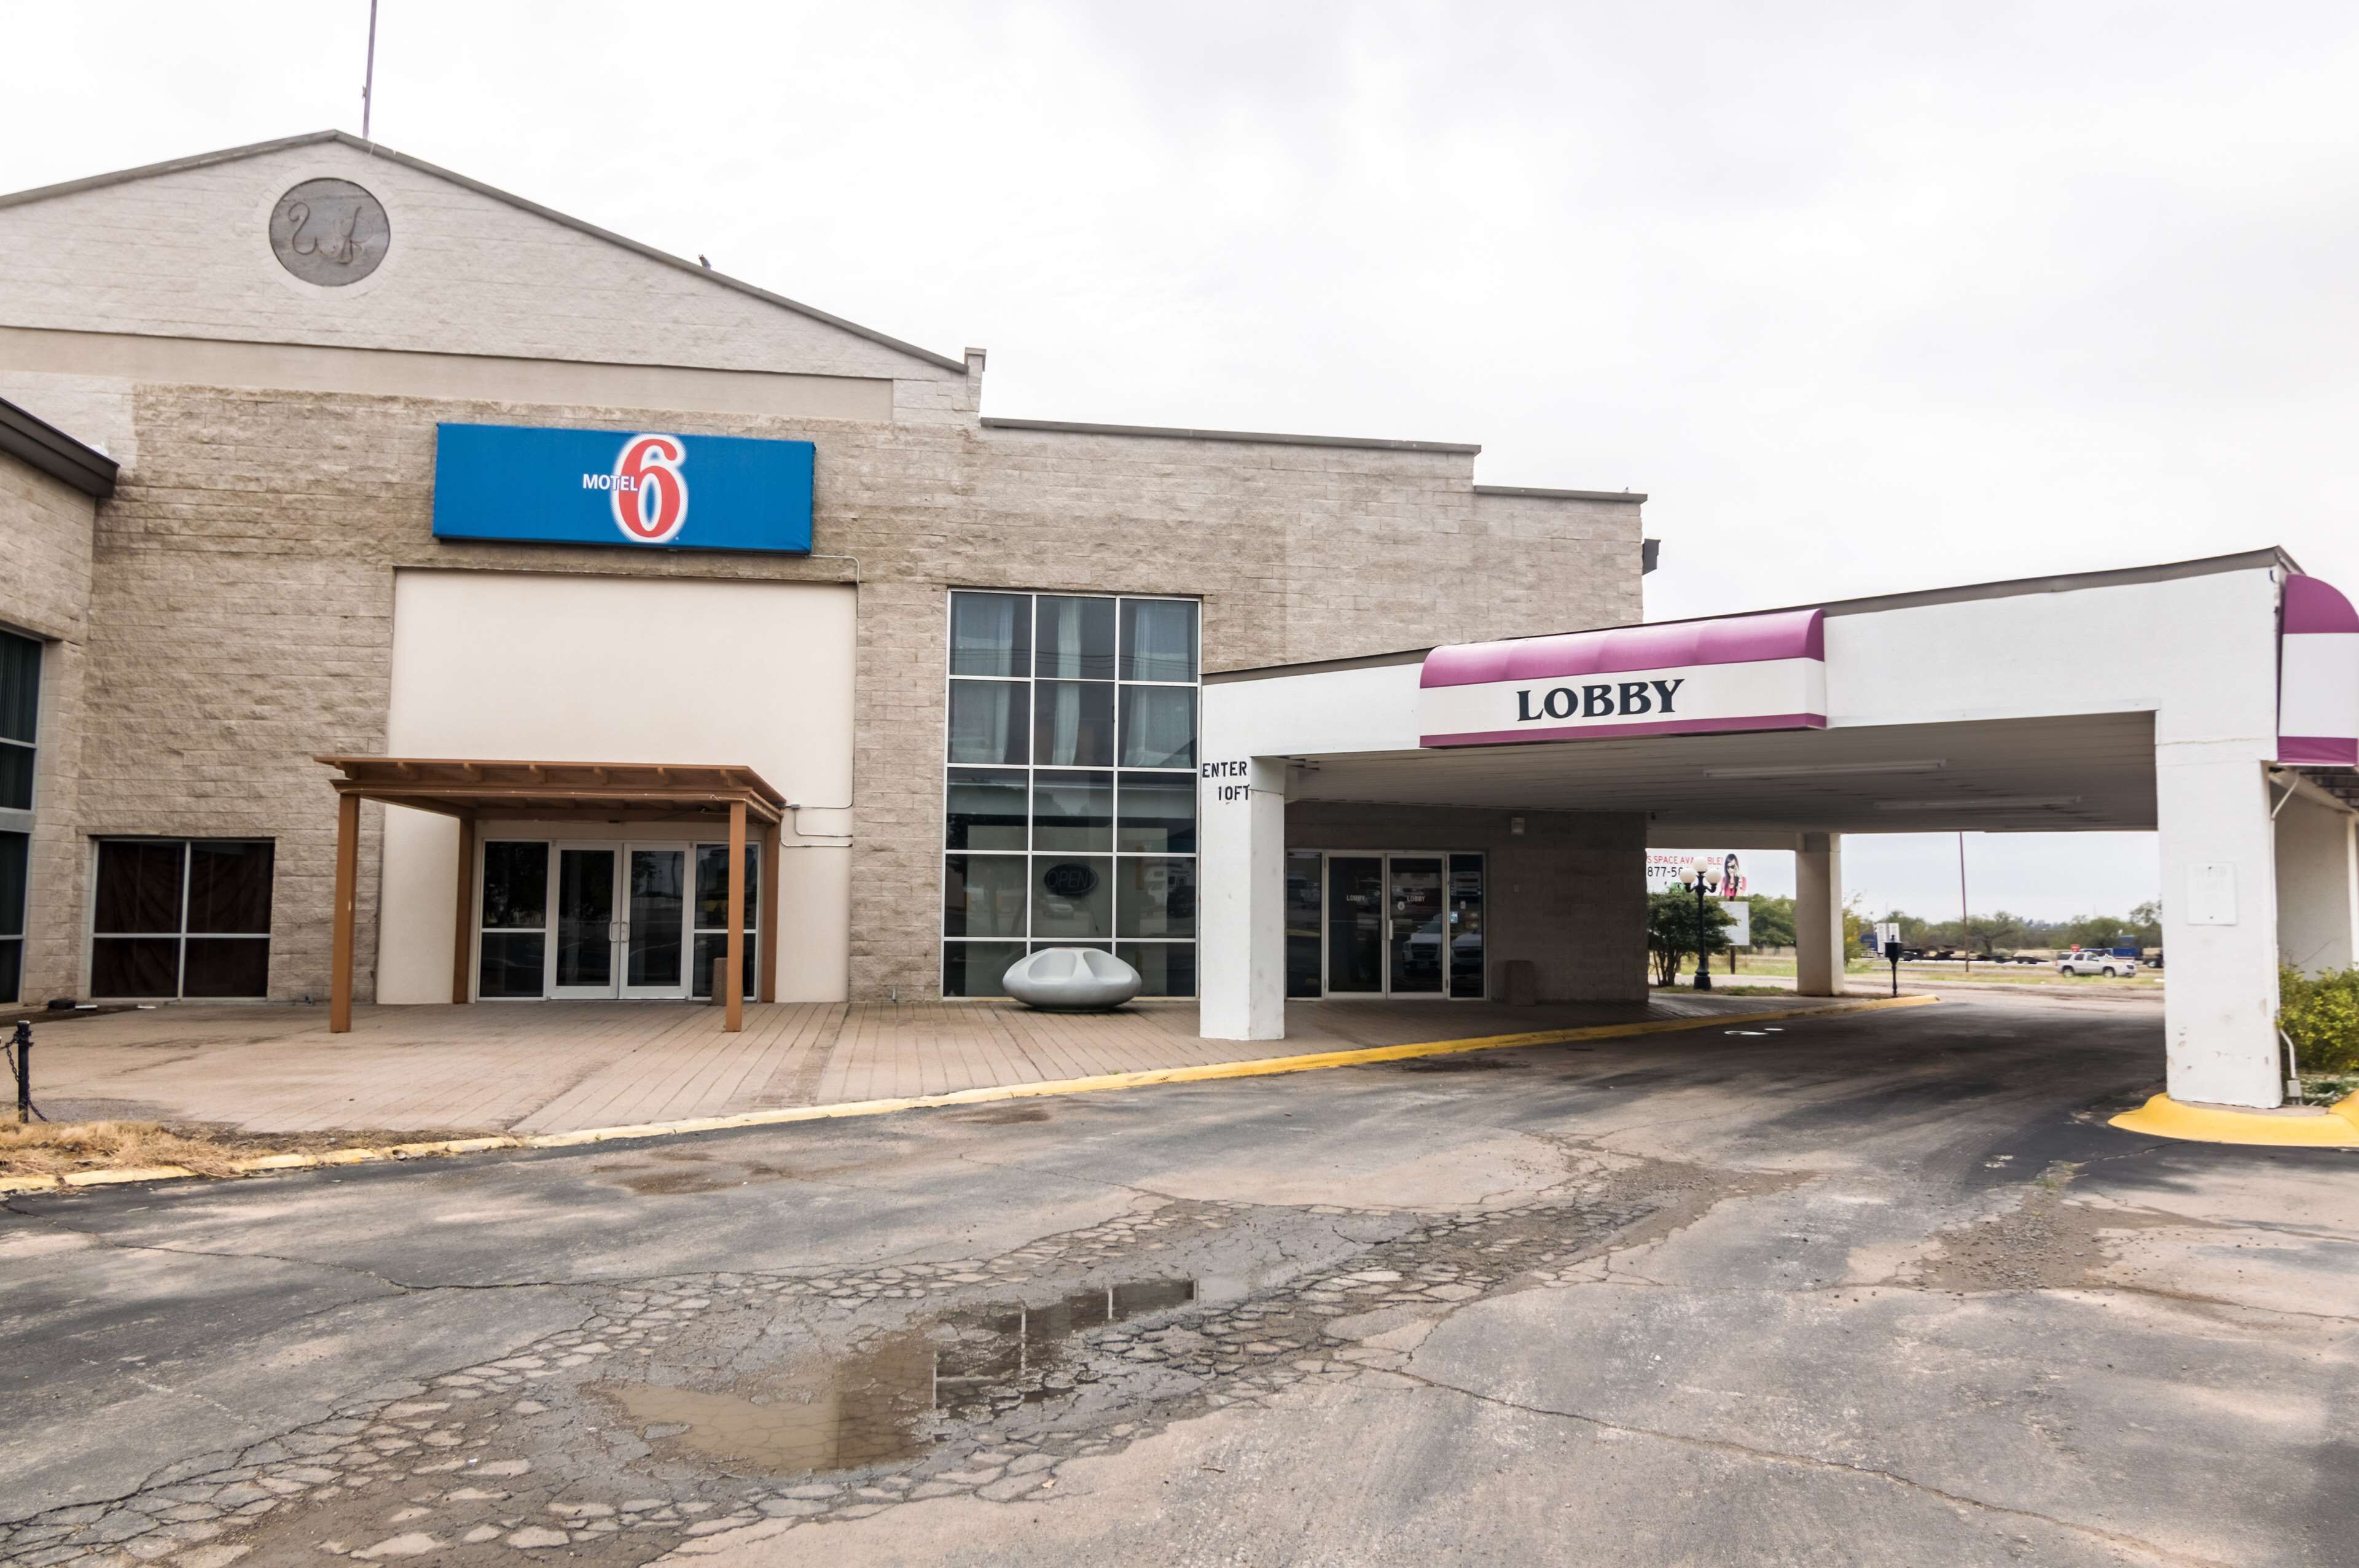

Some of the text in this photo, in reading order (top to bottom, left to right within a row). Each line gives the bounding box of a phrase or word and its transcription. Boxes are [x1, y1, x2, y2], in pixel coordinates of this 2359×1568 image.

[583, 437, 684, 540] MOTEL 6
[1516, 679, 1685, 722] LOBBY
[1202, 761, 1247, 778] ENTER
[1218, 784, 1250, 801] 10FT
[1654, 856, 1678, 864] SPACE
[1047, 870, 1089, 888] OPEN
